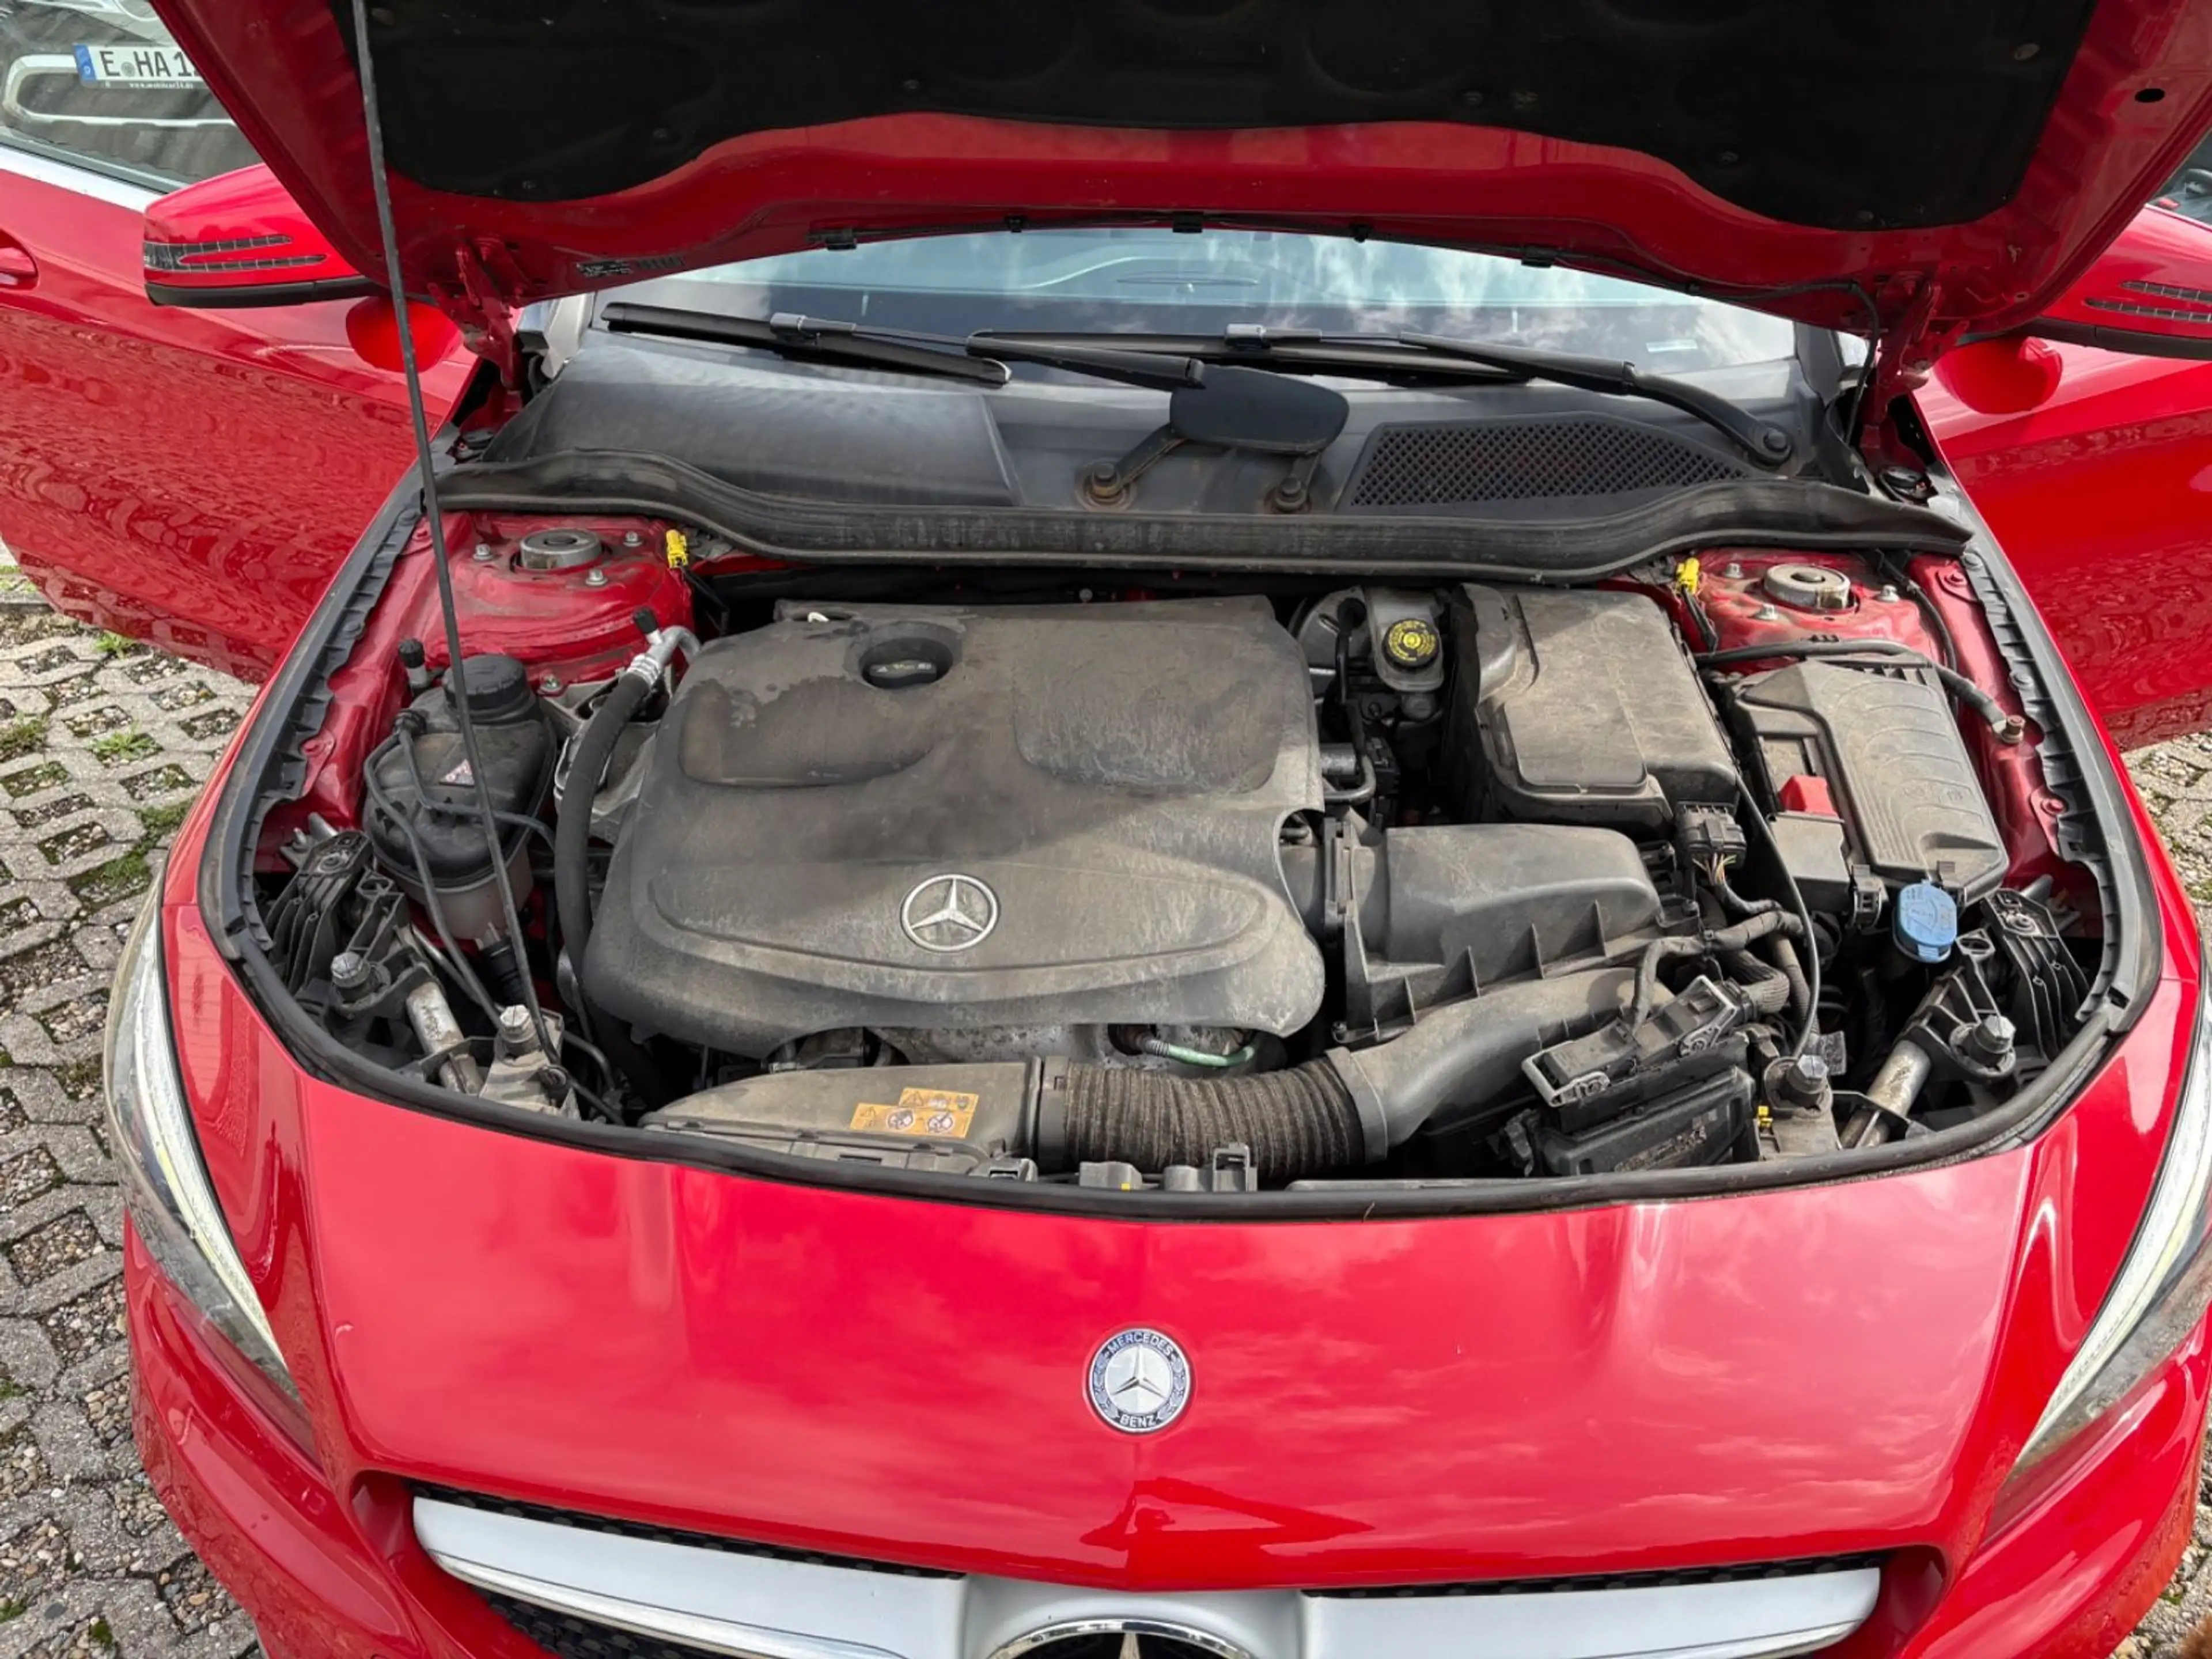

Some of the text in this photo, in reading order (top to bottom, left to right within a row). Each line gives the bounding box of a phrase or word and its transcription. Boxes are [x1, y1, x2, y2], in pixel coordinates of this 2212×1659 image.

[100, 51, 120, 77] E
[133, 51, 171, 77] HA
[1107, 1333, 1173, 1357] MERCEDES
[1119, 1414, 1157, 1428] BENZ
